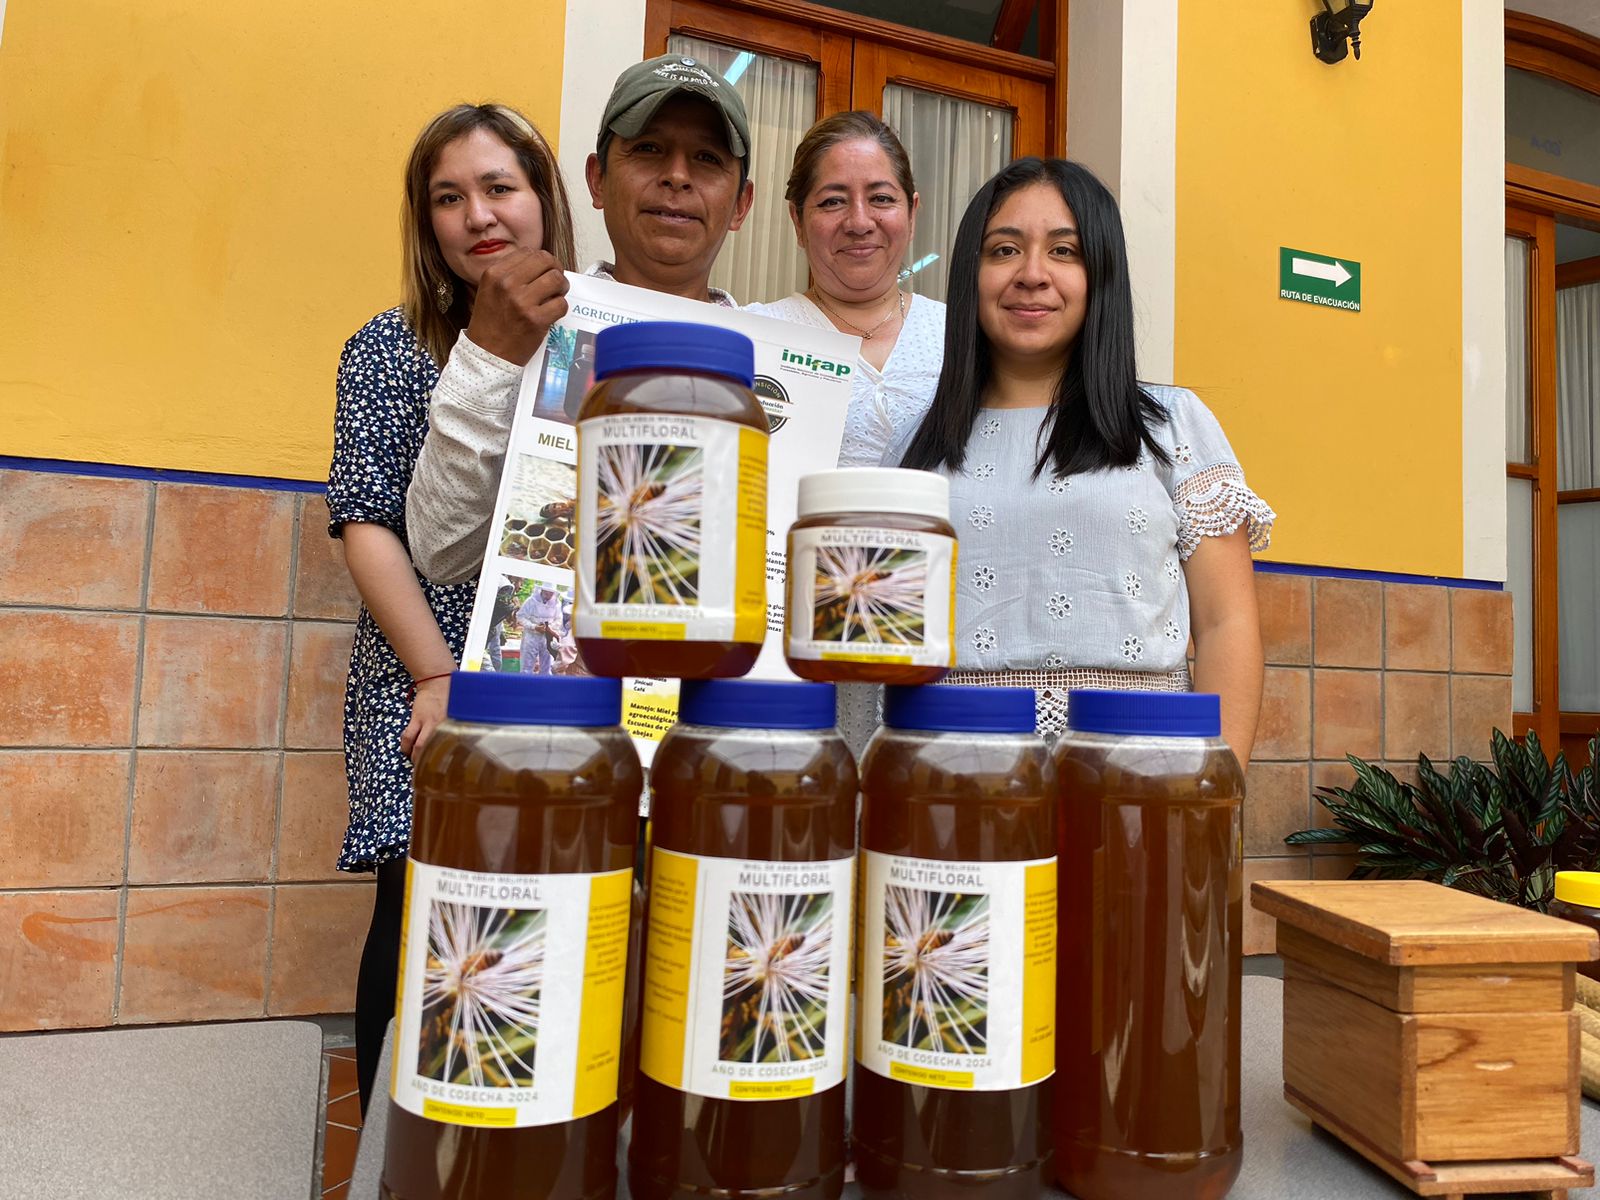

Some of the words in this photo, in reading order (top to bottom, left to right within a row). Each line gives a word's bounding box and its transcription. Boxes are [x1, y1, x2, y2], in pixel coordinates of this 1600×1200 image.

[1281, 289, 1300, 300] RUTA
[1302, 293, 1312, 302] DE
[1313, 295, 1360, 311] EVACUACIÓN
[782, 349, 851, 376] inifap
[603, 424, 697, 440] MULTIFLORAL
[538, 432, 574, 451] MIEL
[821, 533, 922, 547] MULTIFLORAL
[630, 702, 656, 712] Manejo:
[656, 707, 671, 715] Miel
[627, 719, 654, 729] Escuelas
[632, 729, 653, 738] abejas
[740, 871, 831, 887] MULTIFLORAL
[890, 866, 984, 887] MULTIFLORAL
[438, 879, 542, 901] MULTIFLORAL
[897, 1049, 909, 1060] DE
[913, 1053, 961, 1067] COSECHA
[965, 1058, 992, 1068] 2024
[740, 1066, 753, 1076] DE
[759, 1065, 805, 1076] COSECHA
[807, 1060, 828, 1072] 2024
[432, 1085, 445, 1096] DE
[449, 1088, 503, 1103] COSECHA
[508, 1091, 538, 1103] 2024
